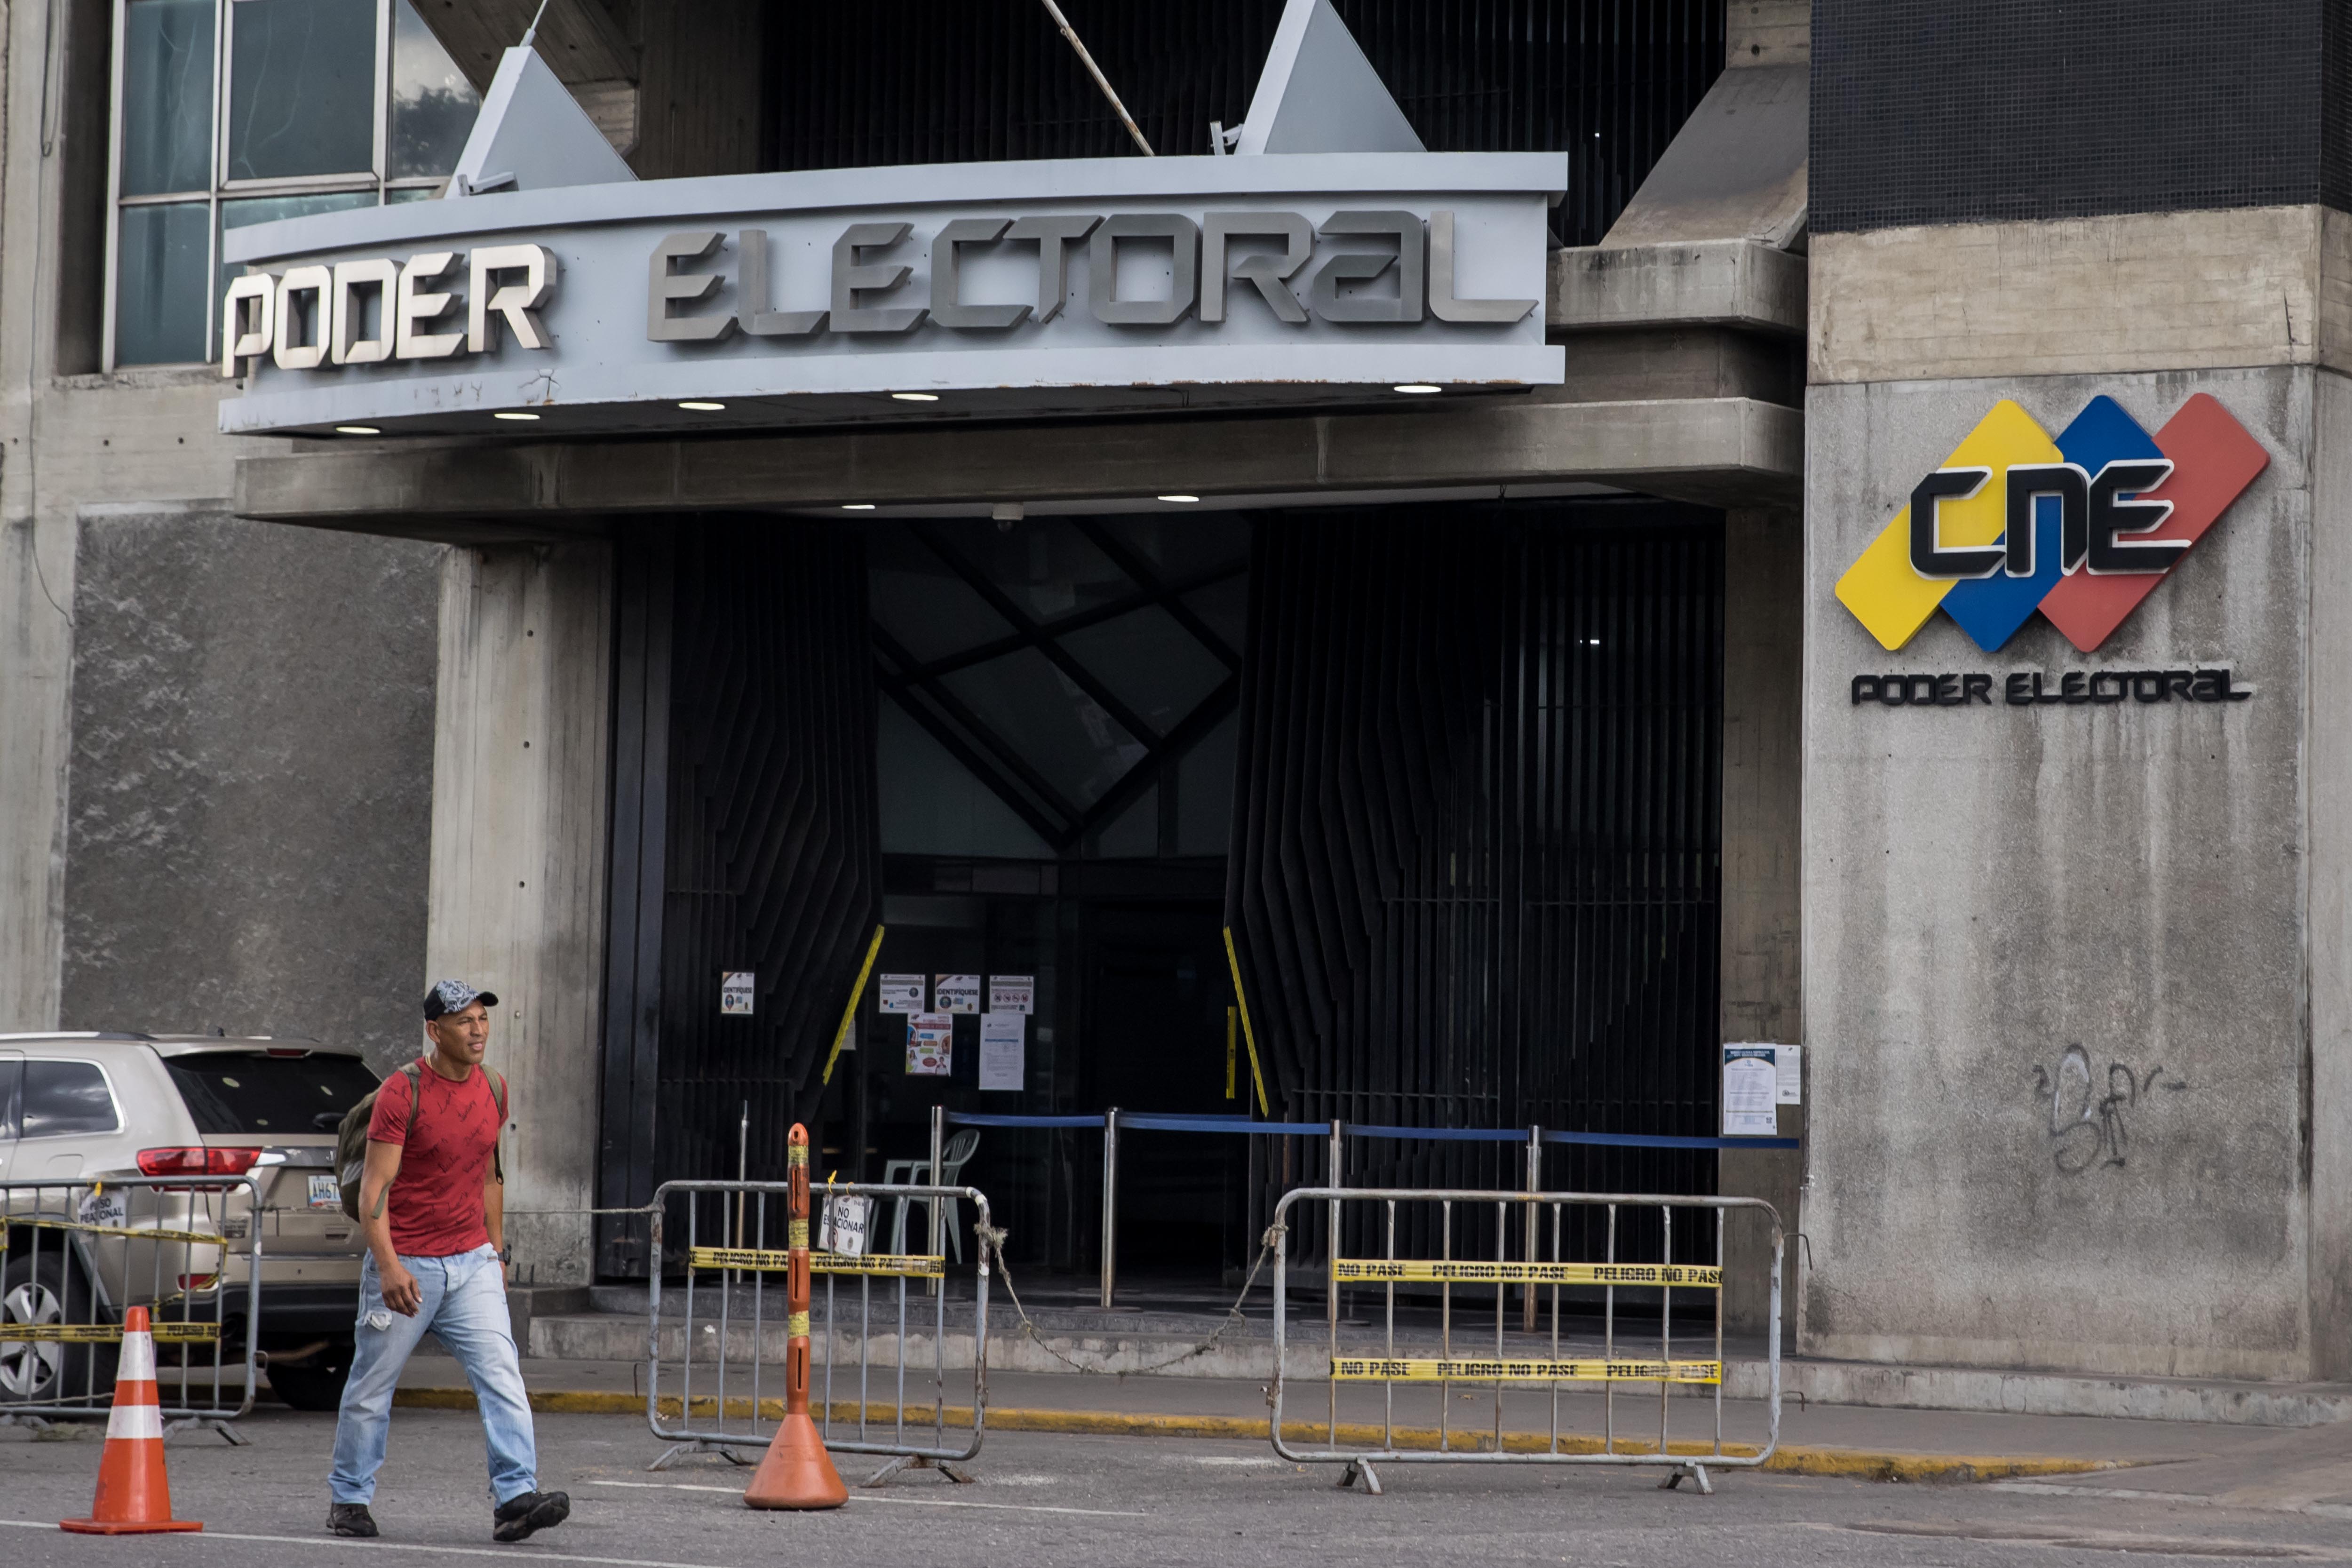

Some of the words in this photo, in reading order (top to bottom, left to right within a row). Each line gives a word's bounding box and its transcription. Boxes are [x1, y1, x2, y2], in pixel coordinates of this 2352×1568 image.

[223, 243, 557, 377] PODER
[1851, 673, 1992, 705] PODER
[89, 1197, 112, 1210] PSO
[79, 1207, 123, 1223] PEAONAL
[837, 1206, 850, 1219] NO
[823, 1214, 865, 1234] ESACIONAR
[756, 1253, 770, 1266] NO
[773, 1254, 788, 1267] PA
[860, 1257, 876, 1268] NO
[1338, 1263, 1361, 1276] NO
[1366, 1264, 1406, 1277] PASE
[1432, 1265, 1496, 1278] PELIGRO
[1501, 1266, 1523, 1278] NO
[1528, 1266, 1568, 1280] PASE
[1593, 1267, 1656, 1281] PELIGRO
[1661, 1268, 1683, 1282] NO
[1341, 1361, 1364, 1375] NO
[1369, 1362, 1411, 1376] PASE
[1437, 1363, 1503, 1377] PELIGRO
[1509, 1363, 1531, 1377] NO
[1537, 1364, 1578, 1376] PASE
[1606, 1365, 1671, 1377] PELIGRO
[1680, 1364, 1718, 1378] PASE
